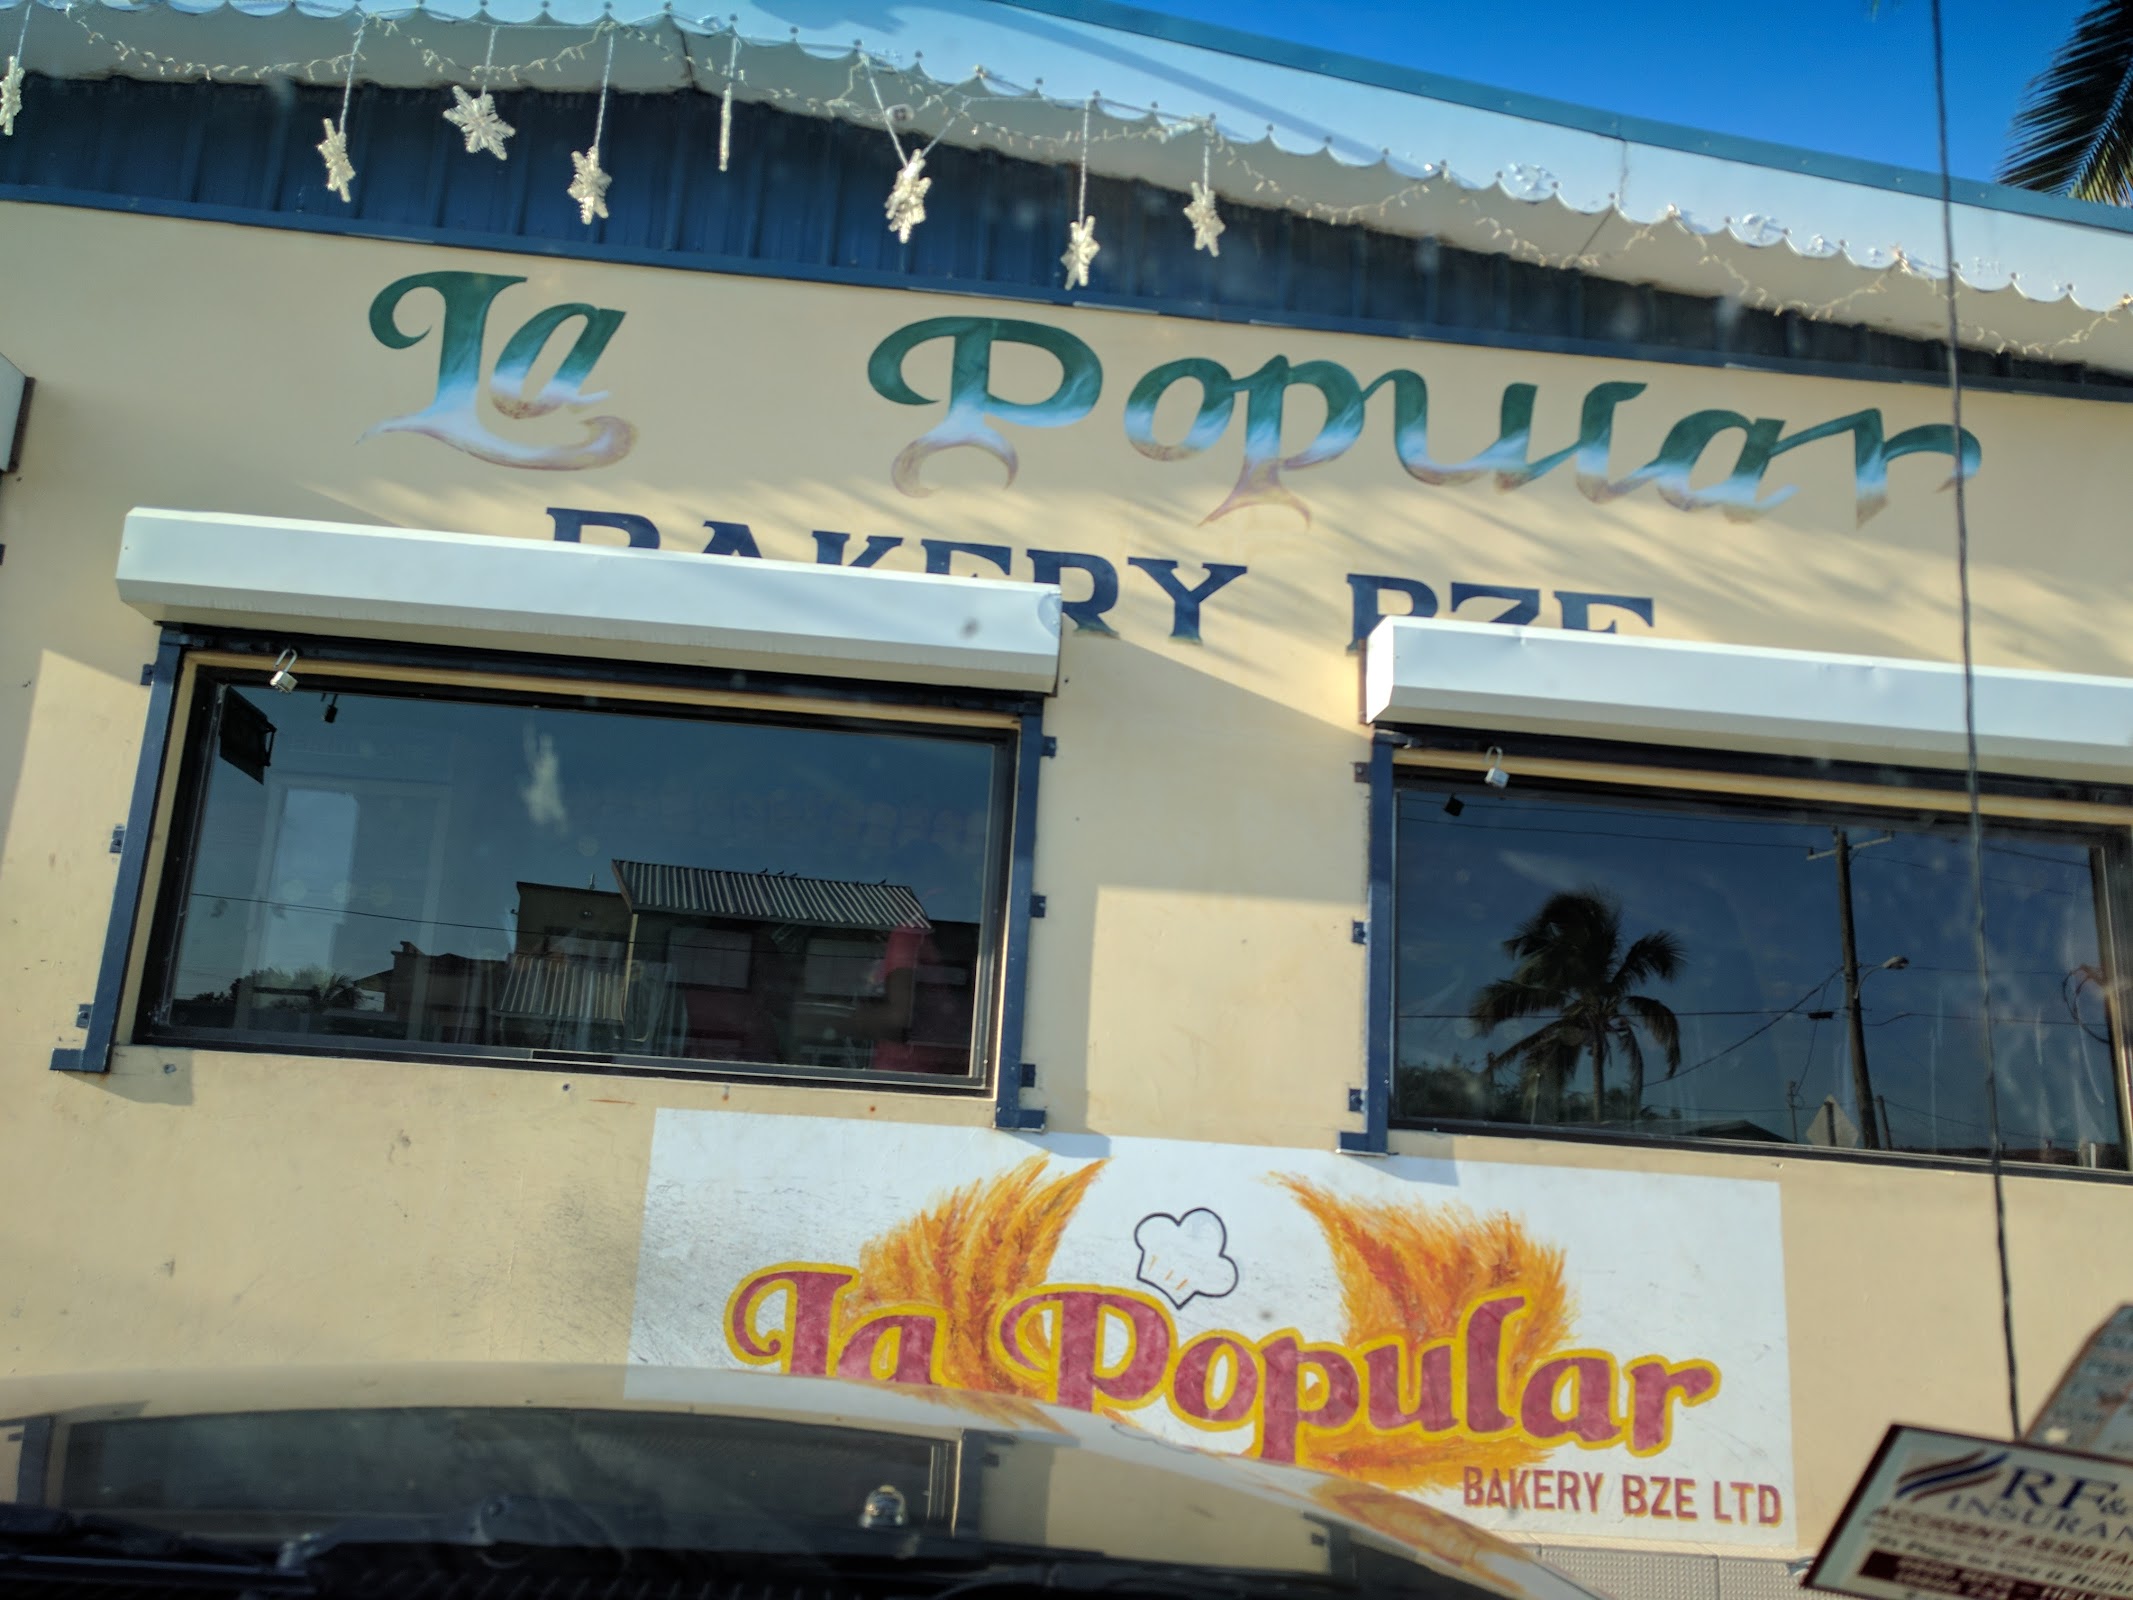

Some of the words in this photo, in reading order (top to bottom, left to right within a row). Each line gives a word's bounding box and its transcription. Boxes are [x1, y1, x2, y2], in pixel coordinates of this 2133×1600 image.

[356, 270, 638, 471] La
[867, 316, 1982, 531] Popular
[724, 1261, 962, 1386] La
[993, 1283, 1722, 1466] Popular
[1463, 1466, 1605, 1514] BAKERY
[1622, 1474, 1699, 1520] BZE
[1713, 1480, 1783, 1527] LTD
